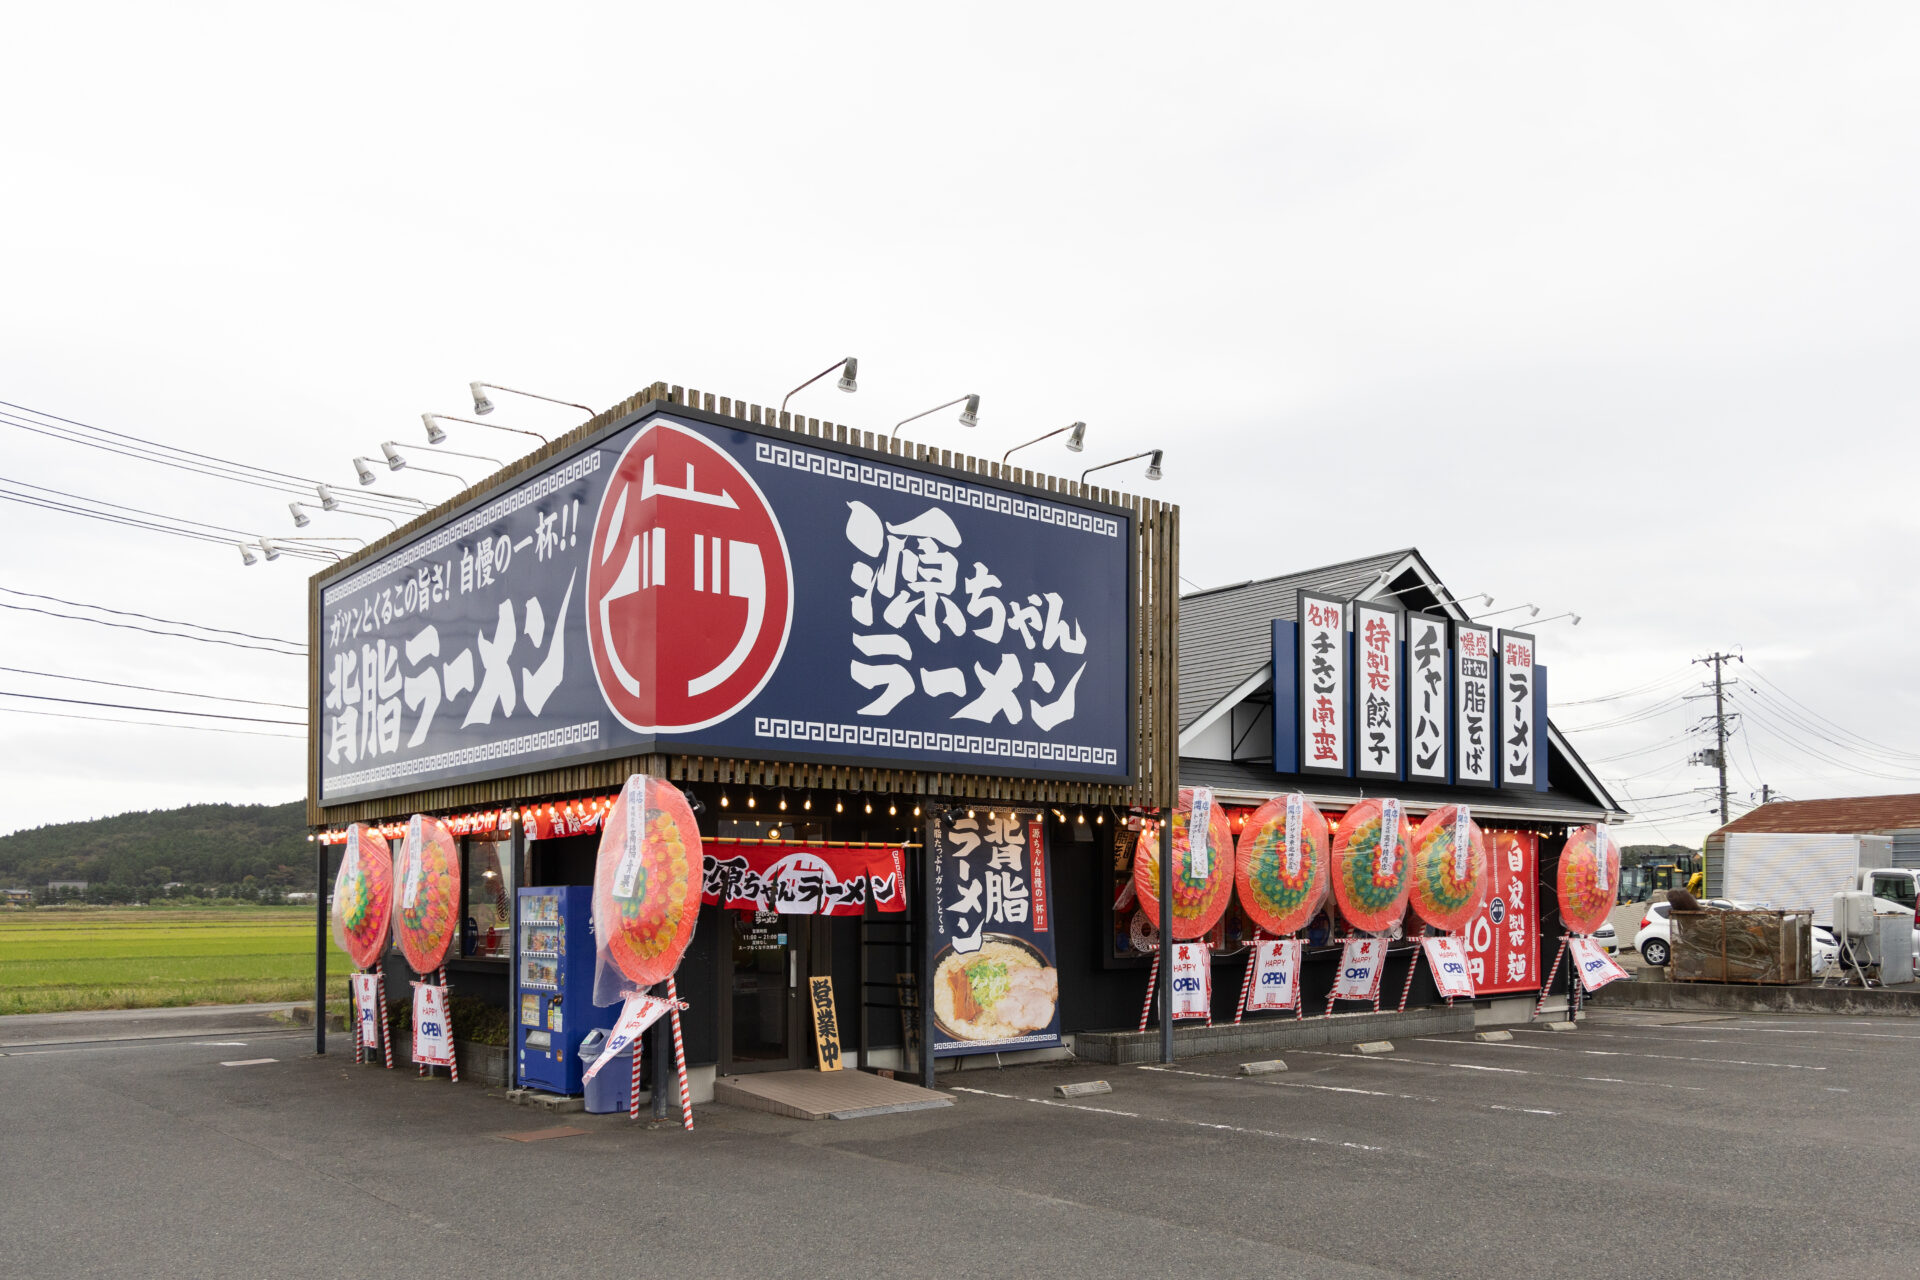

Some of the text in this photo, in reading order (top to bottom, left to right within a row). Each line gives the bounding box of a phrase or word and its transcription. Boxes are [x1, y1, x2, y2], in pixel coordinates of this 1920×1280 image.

[845, 500, 1087, 643] 源ちゃん
[1308, 603, 1339, 630] 名物
[1460, 631, 1488, 658] 爆盛
[326, 567, 578, 764] 背脂ラーメン
[850, 632, 1086, 732] ラーメン
[1463, 660, 1487, 678] 汁なし
[1505, 643, 1531, 667] 背脂
[1311, 631, 1338, 762] チキン南蛮
[1365, 617, 1392, 765] 特製餃子
[1415, 625, 1442, 770] チャーハン
[1508, 673, 1530, 777] ラーメン
[1463, 680, 1485, 775] 脂そば
[702, 855, 896, 905] 源ちゃんラーメン
[945, 819, 985, 952] ラーメン
[984, 818, 1029, 923] 背脂
[1506, 839, 1527, 983] 自家製麺
[1173, 963, 1196, 973] HAPPY
[1173, 977, 1200, 992] OPEN
[1178, 945, 1191, 960] 祝
[1262, 972, 1286, 985] OPEN
[1265, 959, 1286, 967] HAPPY
[1345, 967, 1370, 979] OPEN
[422, 1022, 442, 1037] OPEN
[813, 979, 839, 1068] 営業中
